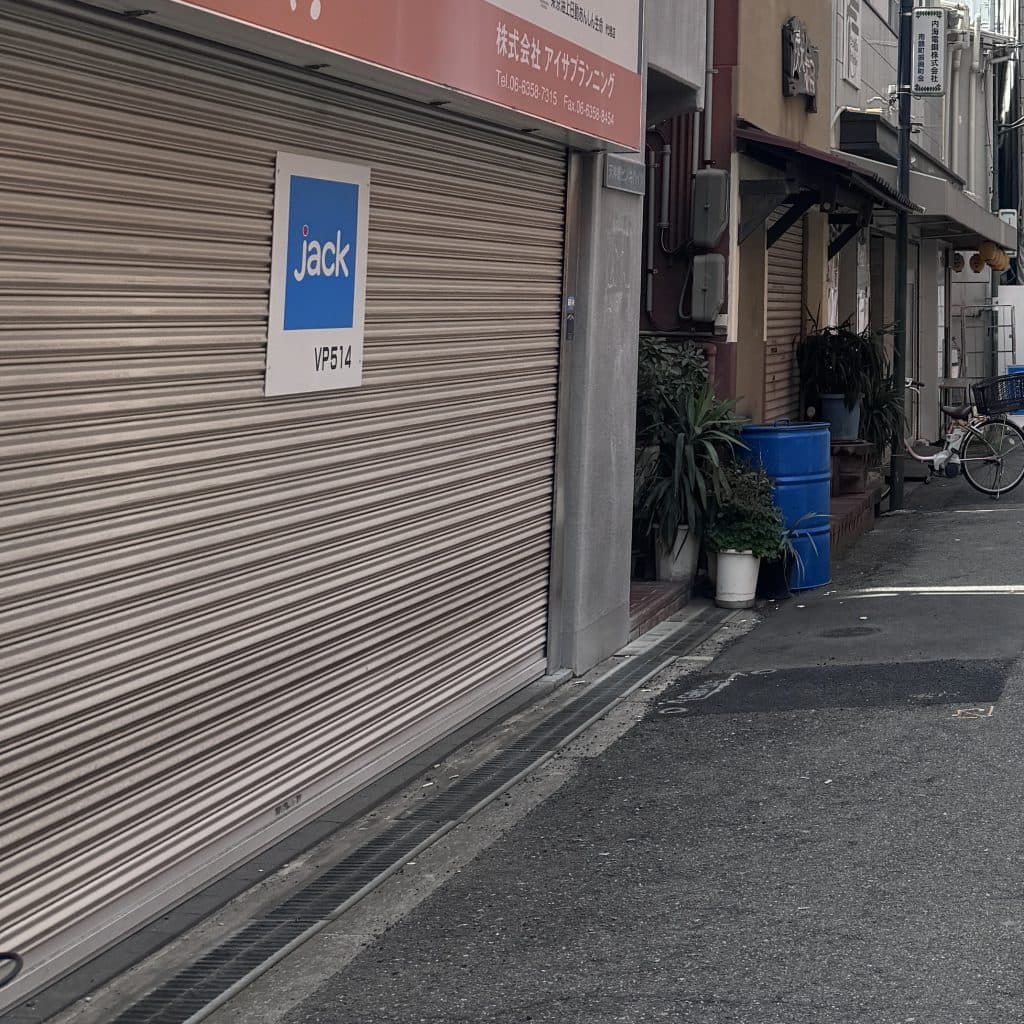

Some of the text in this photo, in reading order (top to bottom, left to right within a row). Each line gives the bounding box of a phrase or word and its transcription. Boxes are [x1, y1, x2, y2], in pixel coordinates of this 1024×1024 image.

[496, 21, 616, 98] 株式会社 アイサプランニング
[294, 225, 350, 282] jack
[314, 345, 352, 371] VP514
